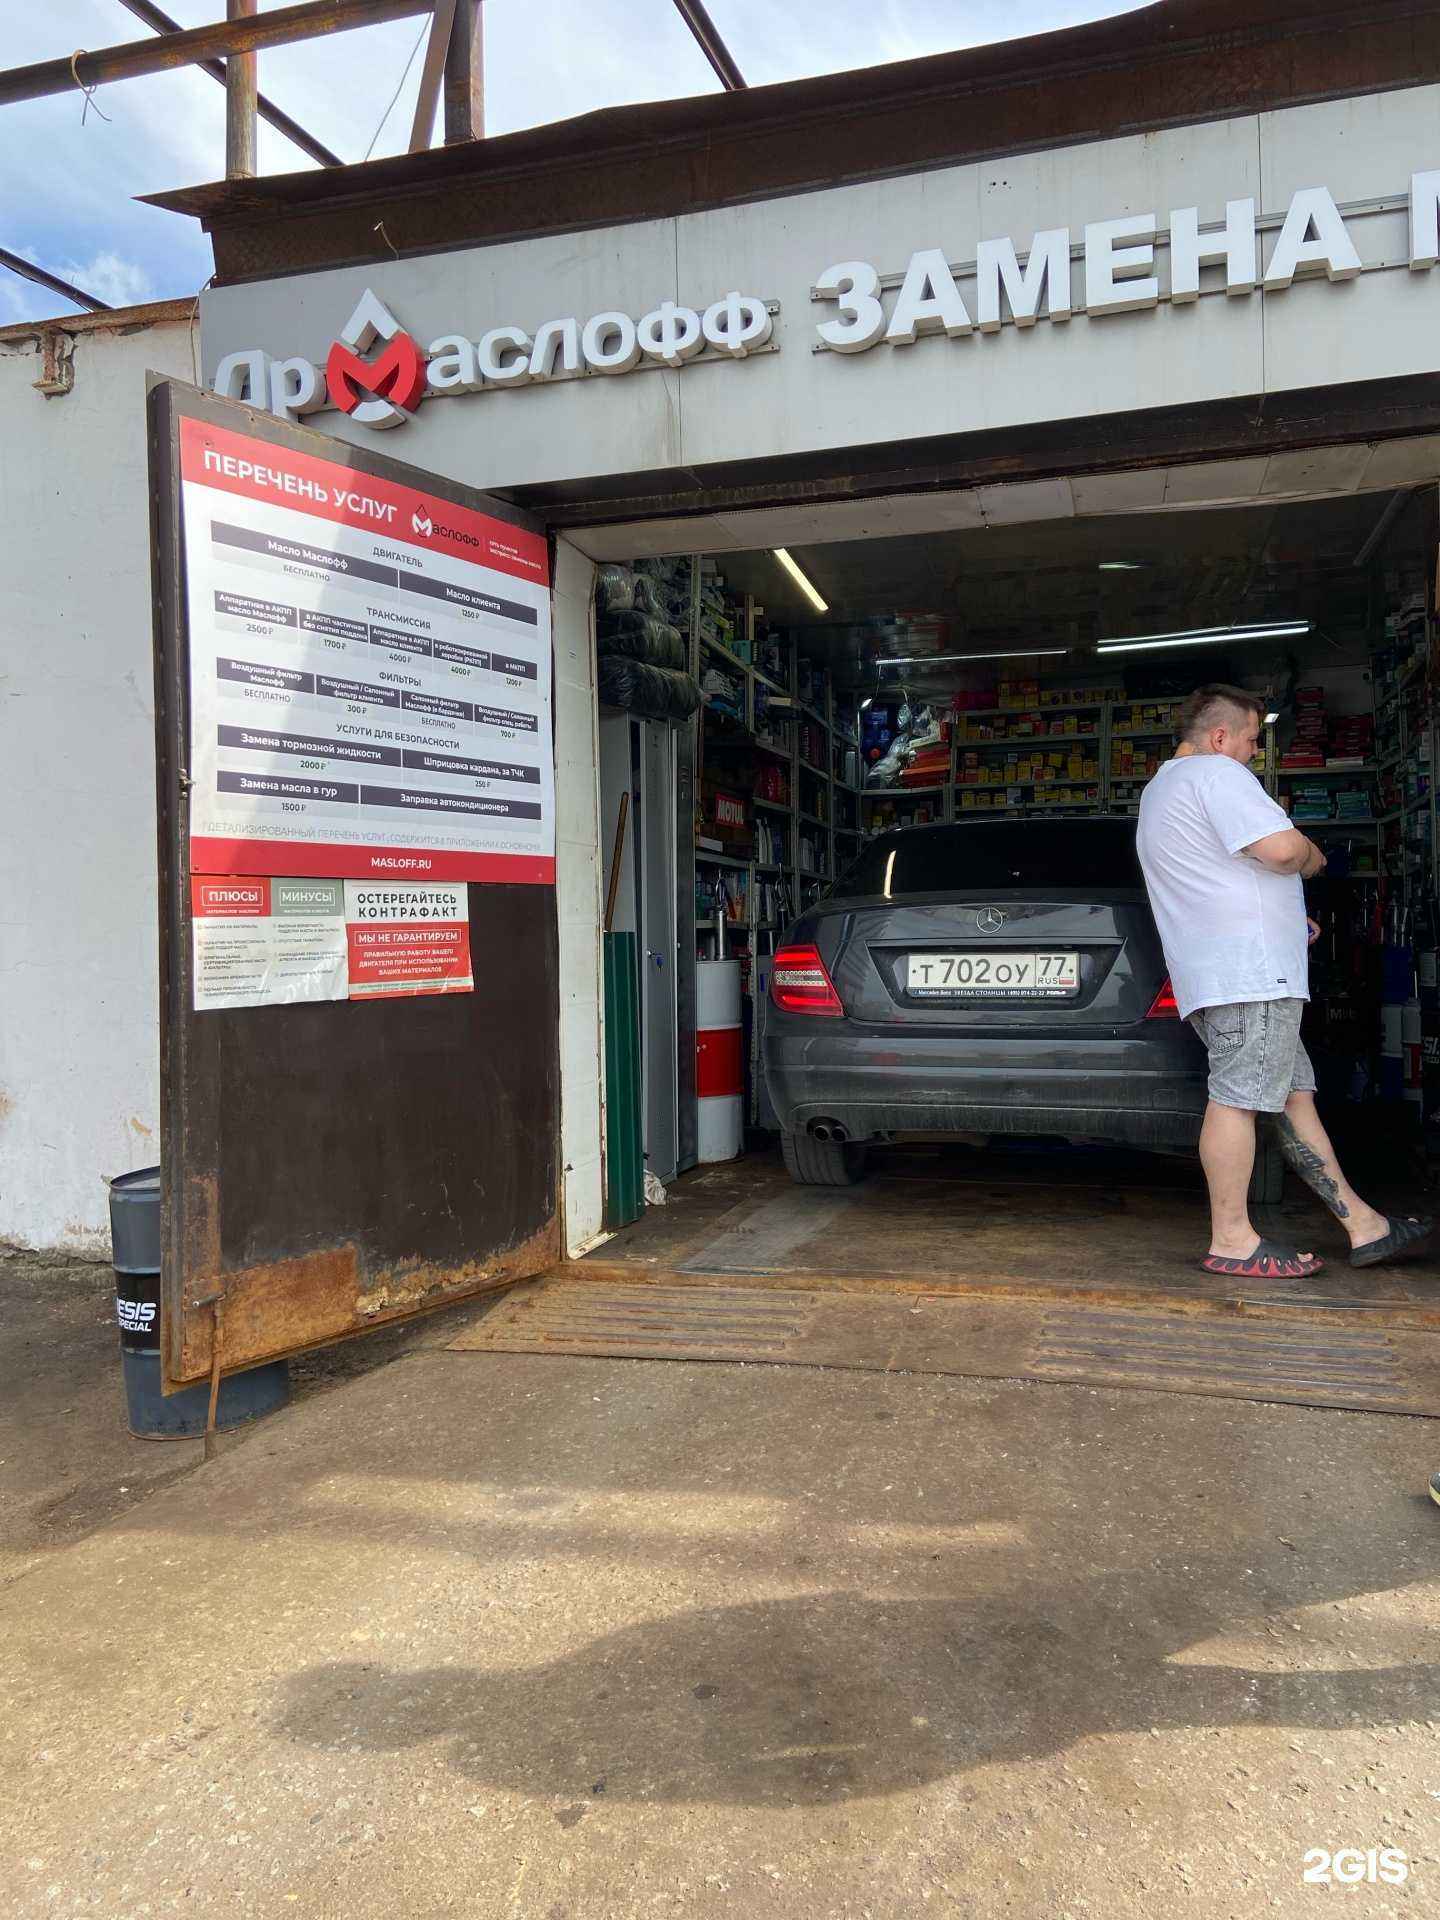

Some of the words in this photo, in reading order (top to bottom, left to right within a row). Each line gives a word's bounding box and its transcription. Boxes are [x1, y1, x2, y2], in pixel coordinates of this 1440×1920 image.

[816, 186, 1362, 352] ЗАМЕНА
[204, 450, 329, 503] ПЕРЕЧЕНЬ
[332, 488, 398, 523] УСЛУГ
[267, 540, 301, 557] Масло
[302, 549, 349, 570] Маслофф
[373, 547, 423, 568] ДВИГАТЕЛЬ
[283, 565, 331, 582] БЕСПЛАТНО
[446, 587, 470, 602] Масло
[471, 594, 501, 610] клиента
[366, 607, 431, 629] ТРАНСМИССИЯ
[379, 671, 422, 687] ФИЛЬТРЫ
[244, 688, 291, 703] БЕСПЛАТНО
[336, 723, 372, 737] УСЛУГИ
[374, 730, 393, 740] ДЛЯ
[395, 734, 460, 749] БЕЗОПАСНОСТИ
[240, 733, 280, 747] Замена
[282, 740, 336, 754] тормозной
[337, 746, 382, 760] жидкости
[424, 757, 469, 771] Шприцовка
[240, 778, 279, 791] Замена
[281, 784, 311, 793] масла
[321, 788, 338, 798] гур
[400, 793, 438, 806] Заправка
[439, 798, 509, 813] автокондиционера
[718, 800, 744, 825] MOTUL
[371, 857, 432, 870] MASLOFF.RU
[209, 890, 258, 903] ПЛЮСЫ
[281, 891, 332, 903] МИНУСЫ
[358, 890, 457, 904] ОСТЕРЕГАЙТЕСЬ
[358, 906, 458, 918] КОНТРАФАКТ
[359, 934, 376, 943] МЫ
[378, 933, 391, 943] НЕ
[393, 932, 458, 943] ГАРАНТИРУЕМ
[1039, 957, 1067, 976] 77
[1037, 977, 1058, 985] RUS
